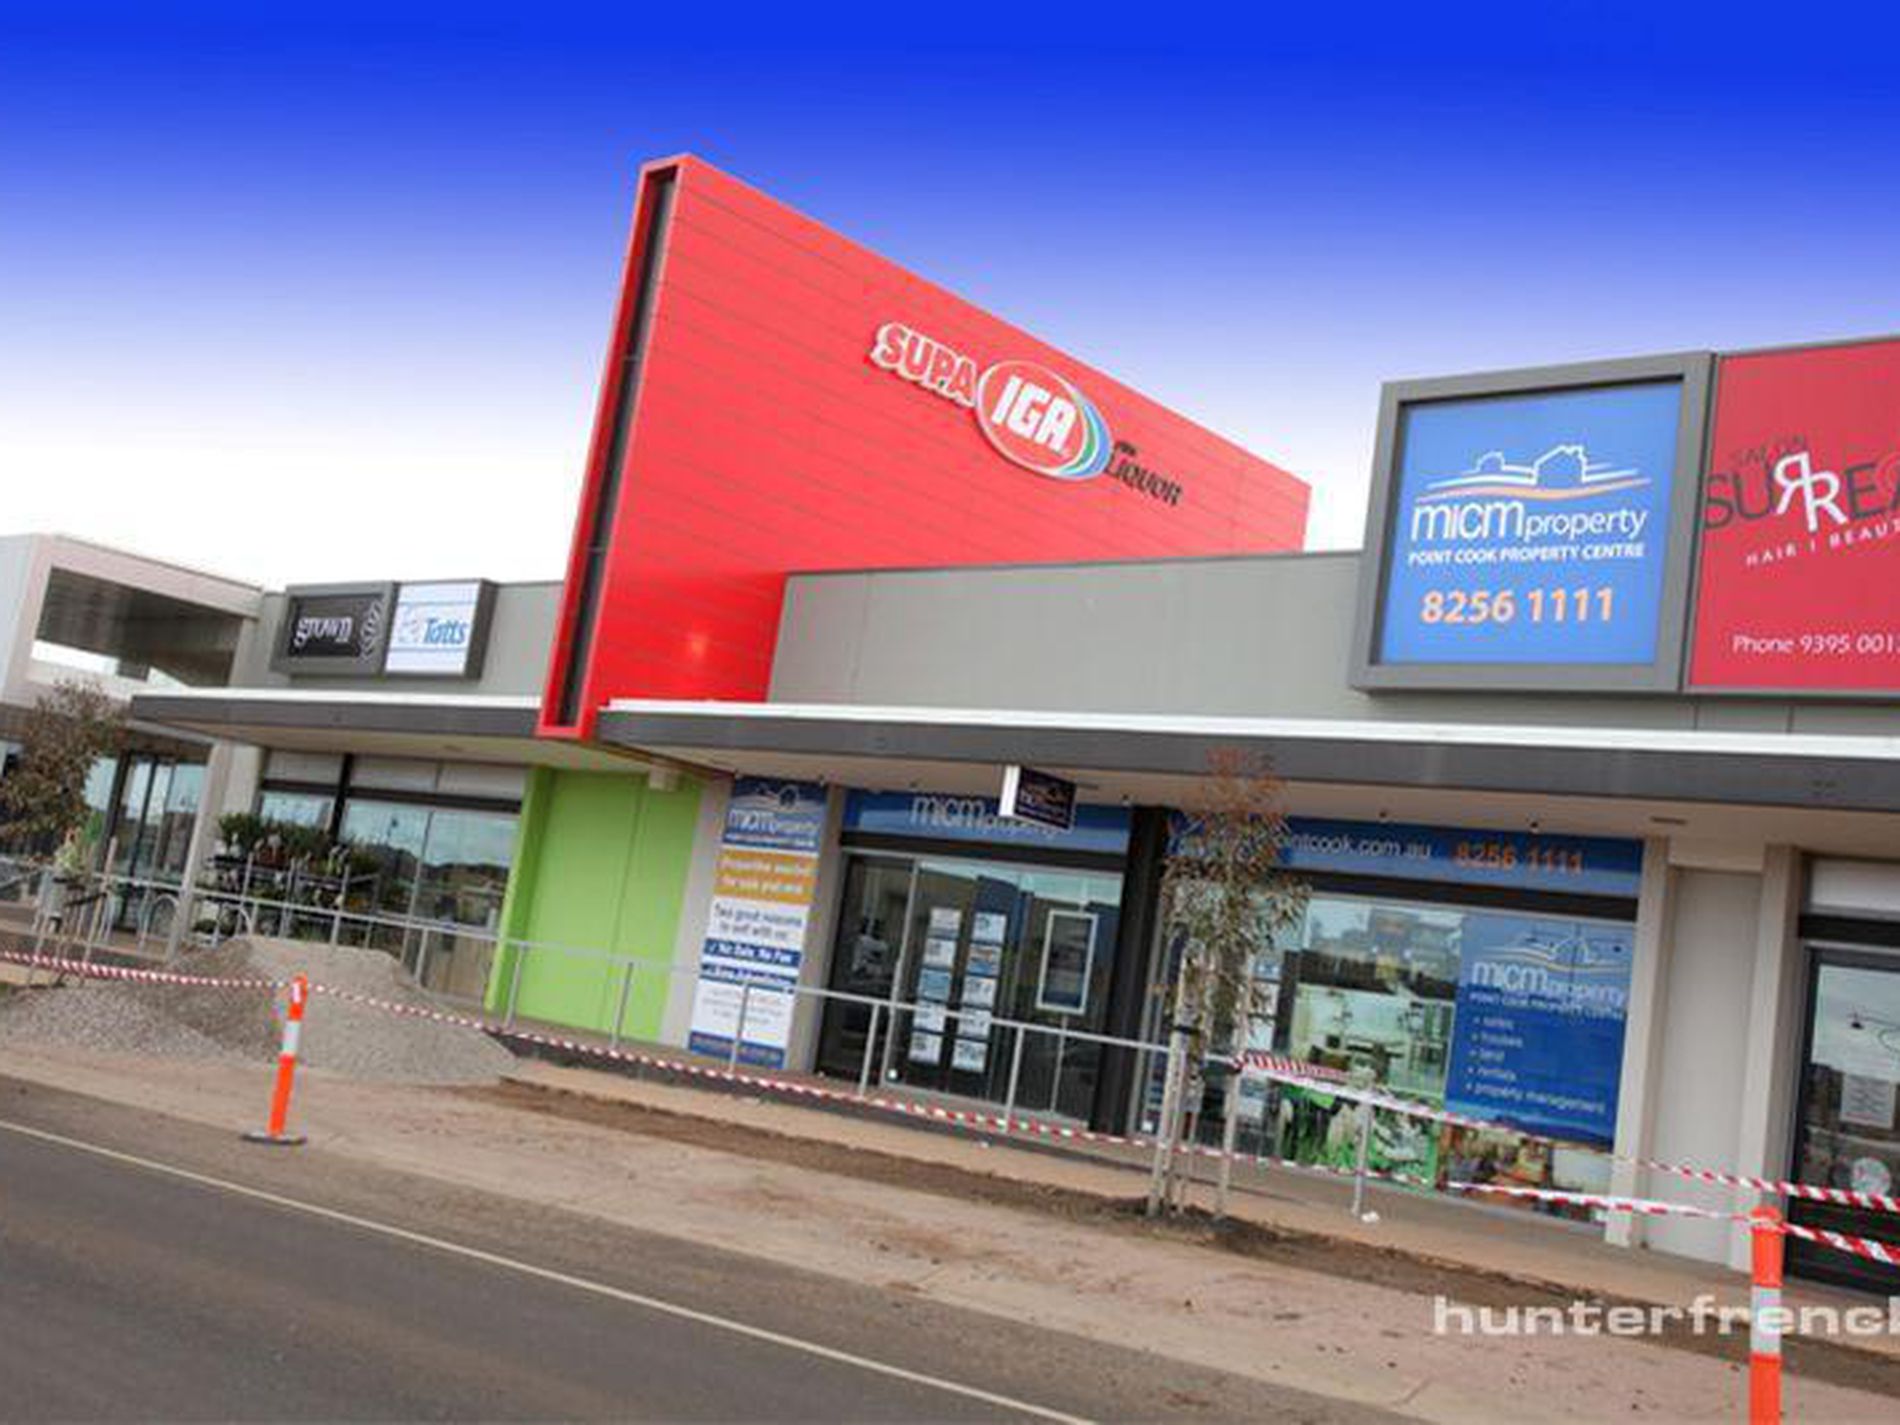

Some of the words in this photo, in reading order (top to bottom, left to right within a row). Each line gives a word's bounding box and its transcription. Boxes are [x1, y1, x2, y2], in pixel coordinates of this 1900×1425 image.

[869, 322, 978, 408] SUPA
[991, 375, 1079, 456] IGA
[1408, 551, 1451, 567] POINT
[1455, 548, 1498, 564] COOK
[1501, 545, 1579, 562] PROPERTY
[1582, 543, 1646, 560] CENTRE
[1746, 542, 1797, 567] HAIR
[1421, 590, 1516, 624] 8256
[1528, 586, 1614, 623] 1111
[423, 618, 469, 644] Tatts
[1732, 633, 1794, 655] Phone
[1799, 633, 1851, 656] 9395
[1456, 842, 1516, 871] 8256
